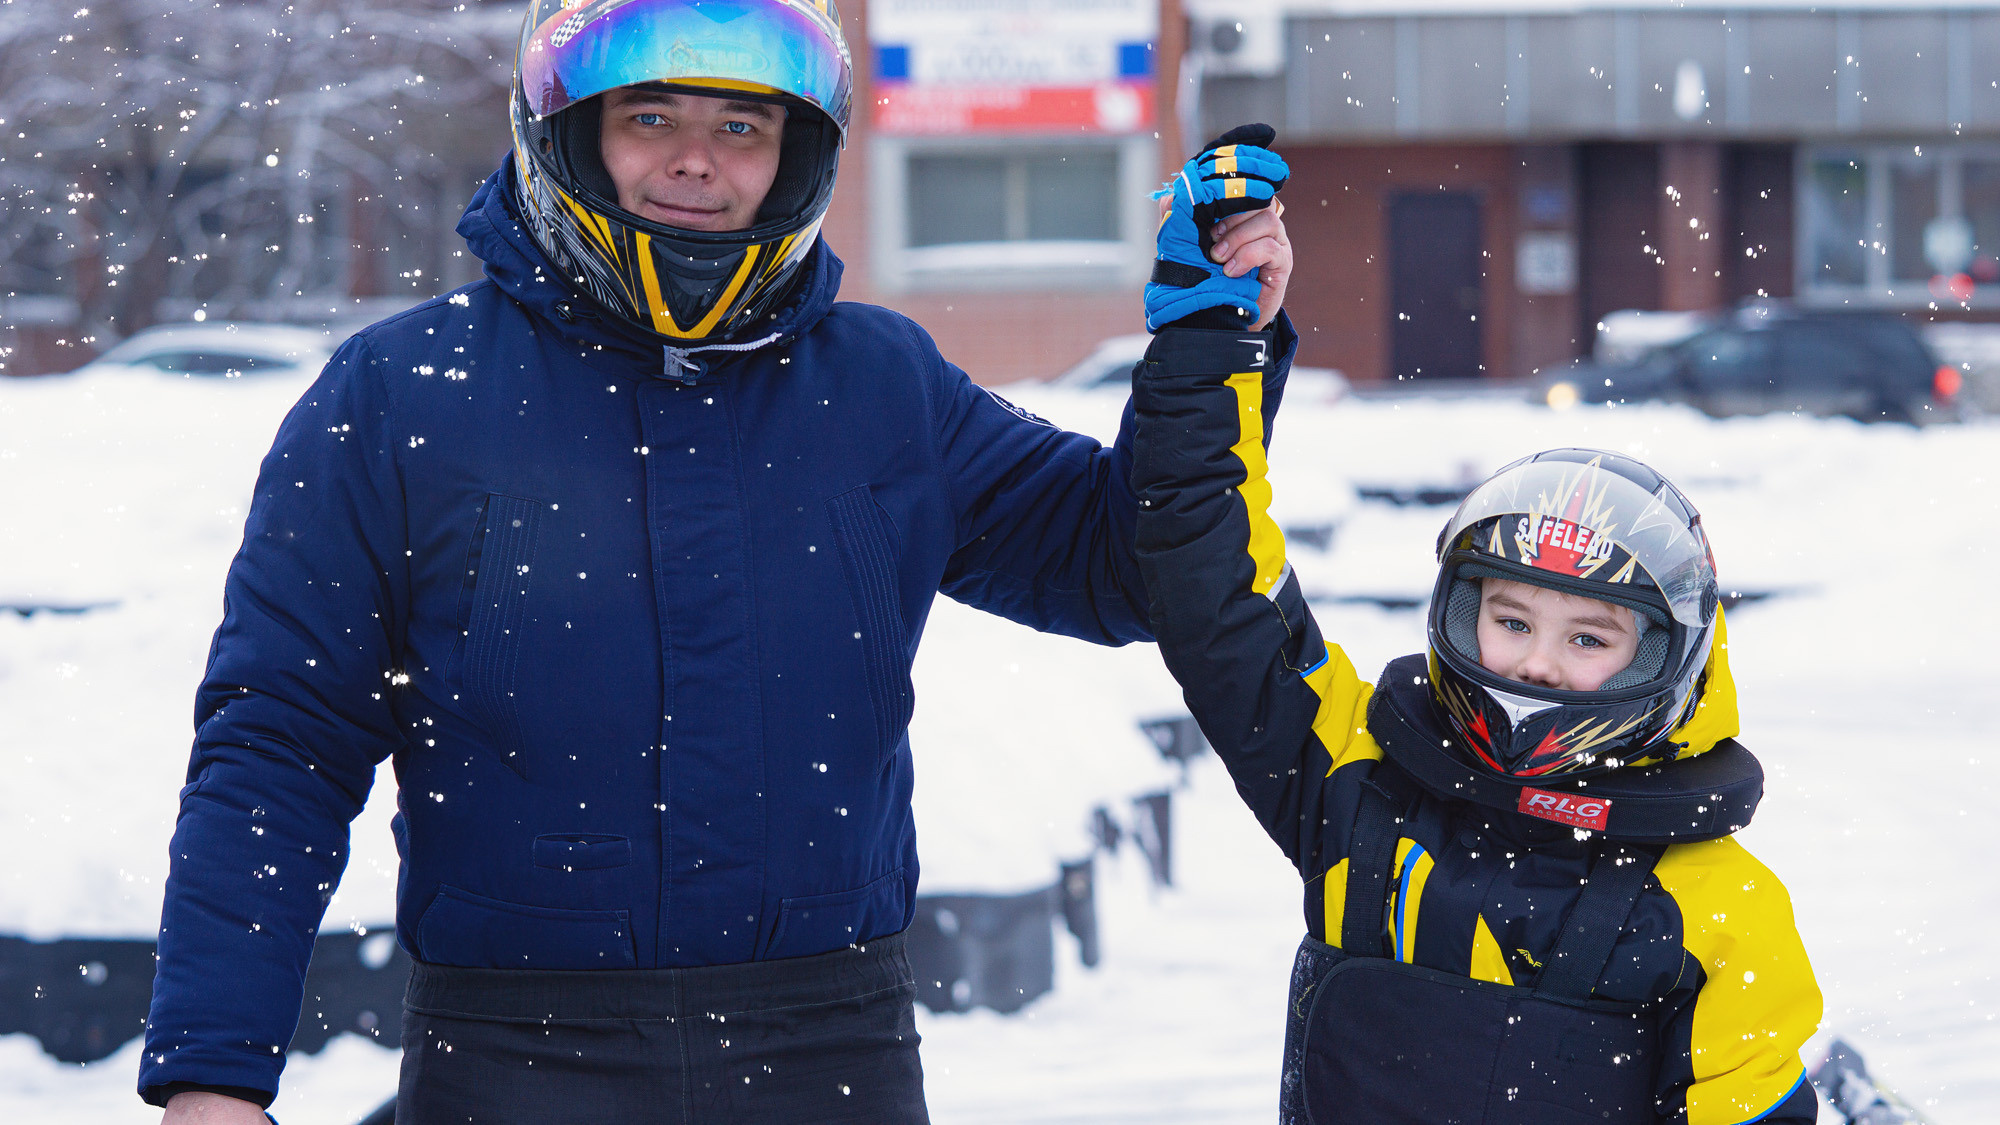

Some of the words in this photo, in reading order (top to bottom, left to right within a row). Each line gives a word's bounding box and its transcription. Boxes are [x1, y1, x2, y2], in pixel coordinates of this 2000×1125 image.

[1515, 517, 1614, 560] SAFELEAD
[1527, 793, 1604, 817] RLG
[1529, 807, 1560, 817] RACE
[1566, 814, 1597, 825] WEAR
